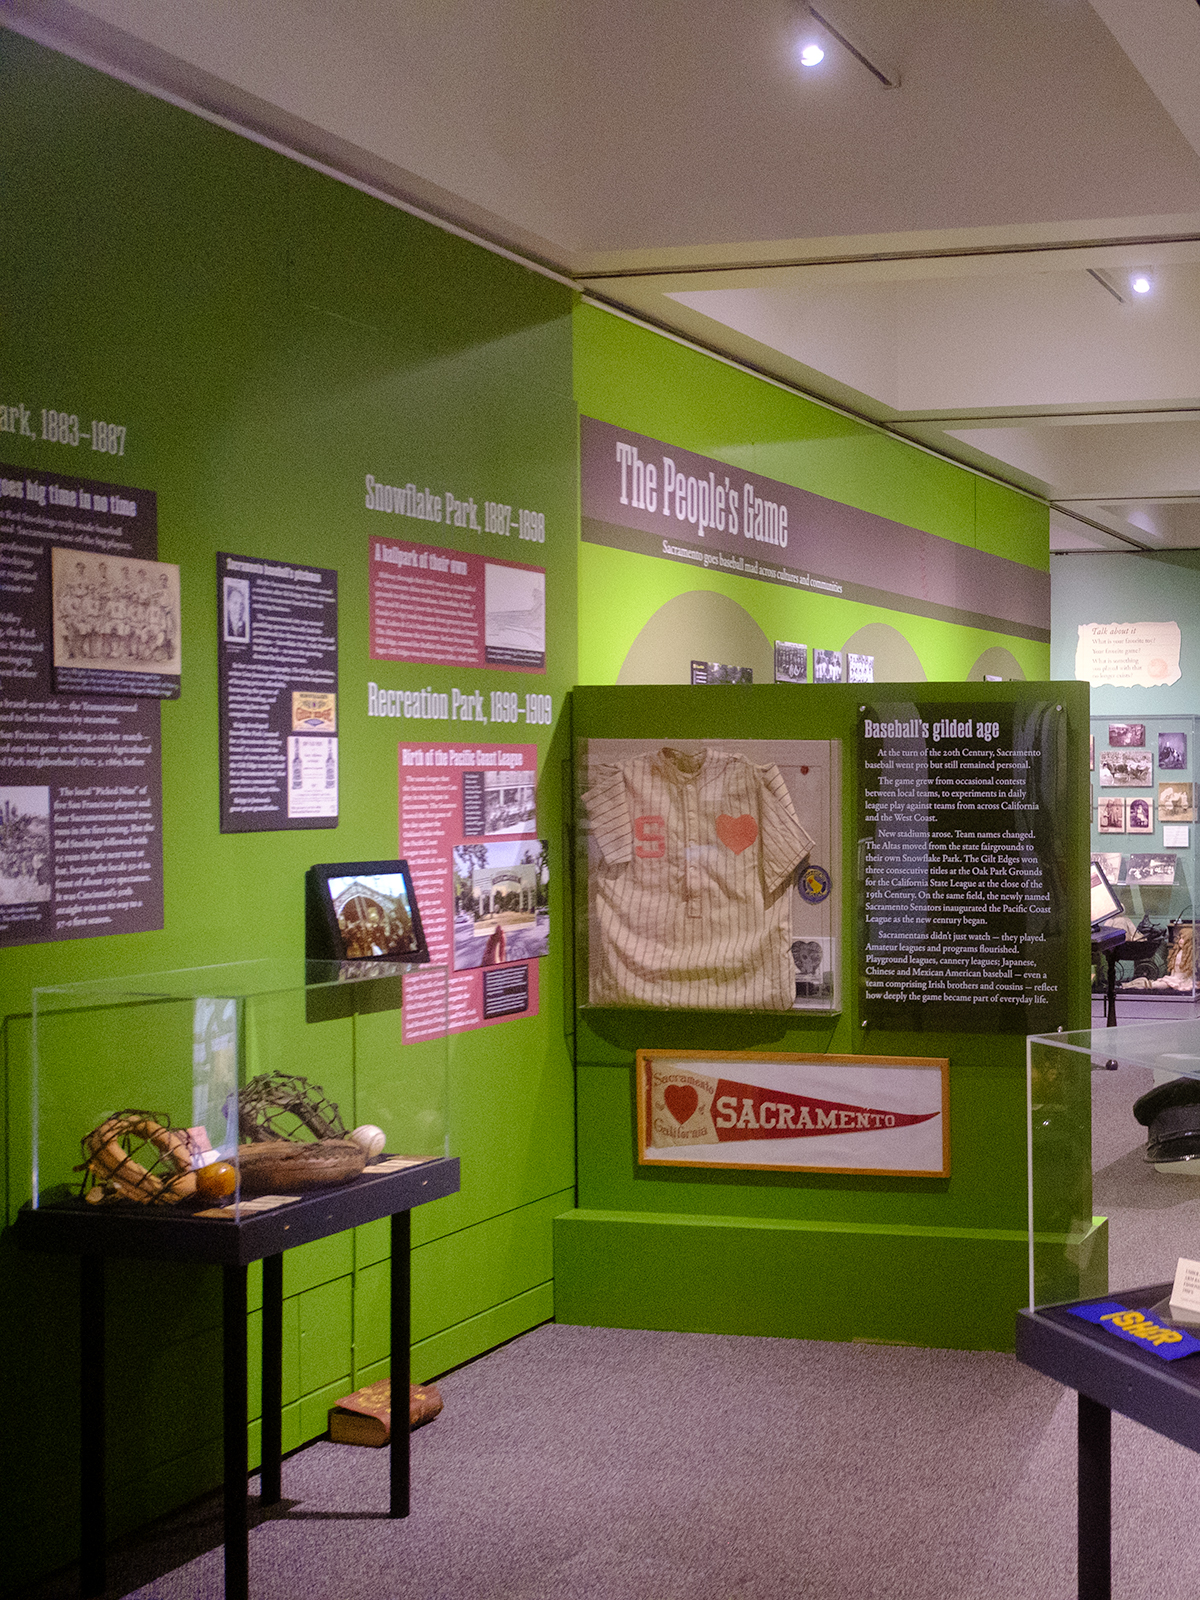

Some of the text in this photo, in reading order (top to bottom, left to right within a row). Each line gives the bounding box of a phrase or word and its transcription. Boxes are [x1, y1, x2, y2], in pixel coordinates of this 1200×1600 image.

[0, 403, 36, 440] ark,
[365, 474, 442, 523] Snowflake
[445, 492, 483, 535] Park,
[616, 441, 788, 548] The People's Game
[662, 540, 843, 593] Sacramento goes baseball mad across cultures and communities
[1092, 627, 1137, 635] Talk about it
[368, 681, 449, 720] Recreation
[451, 688, 488, 726] Park,
[864, 719, 1000, 742] Baseball's gilded age
[402, 748, 523, 769] Birth of the Pacific Coast League
[877, 776, 1026, 787] The game grew from occasional contests
[864, 788, 1027, 800] between local teams, to experiments in daily
[864, 801, 888, 812] league
[889, 801, 905, 812] play
[906, 801, 932, 812] against
[933, 801, 955, 810] teams
[956, 801, 975, 810] from
[1000, 801, 1039, 810] California
[864, 813, 938, 822] and the West Coast.
[634, 815, 666, 859] S
[865, 902, 1051, 914] Sacramento Senators inaugurated the Pacific Coast
[878, 931, 1046, 944] Sacramentans didn't just watch they played.
[865, 943, 1019, 955] Amateur leagues and programs flourished.
[866, 979, 1058, 992] team comprising Irish brothers and cousins reflect
[653, 1072, 715, 1095] Sacramento
[716, 1095, 896, 1130] SACRAMENTO
[653, 1118, 708, 1140] California
